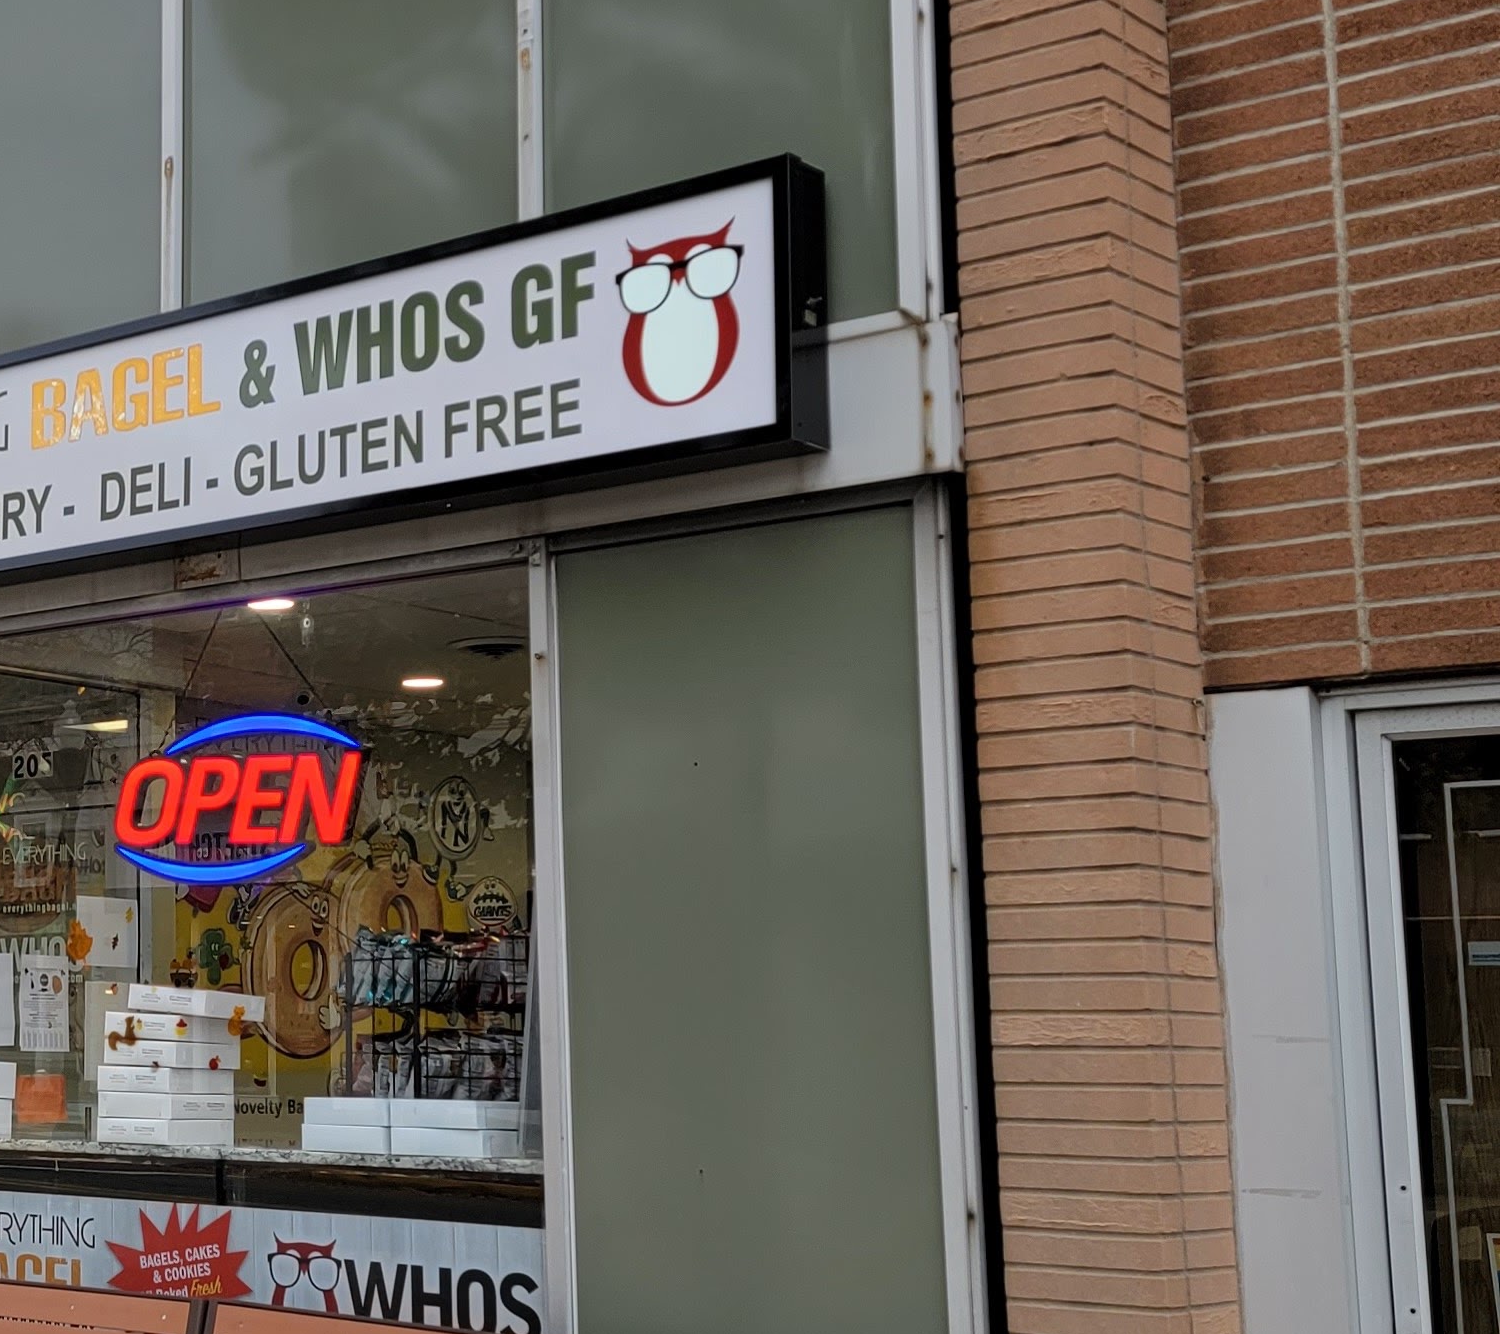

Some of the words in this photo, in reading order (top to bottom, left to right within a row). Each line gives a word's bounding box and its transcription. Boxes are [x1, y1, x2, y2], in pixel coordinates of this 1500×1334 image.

[31, 343, 221, 450] BAGEL
[239, 339, 276, 408] &
[293, 279, 486, 396] WHOS
[511, 250, 596, 349] GF
[100, 456, 191, 522] DELI
[233, 410, 423, 496] GLUTEN
[444, 378, 582, 459] FREE
[114, 750, 362, 846] OPEN
[2, 842, 86, 865] EVERYTHING
[288, 1099, 304, 1114] Ba
[140, 1247, 184, 1269] BAGELS,
[185, 1244, 220, 1262] CAKES
[153, 1269, 162, 1283] &
[164, 1263, 211, 1282] COOKIES
[190, 1275, 222, 1297] Fresh
